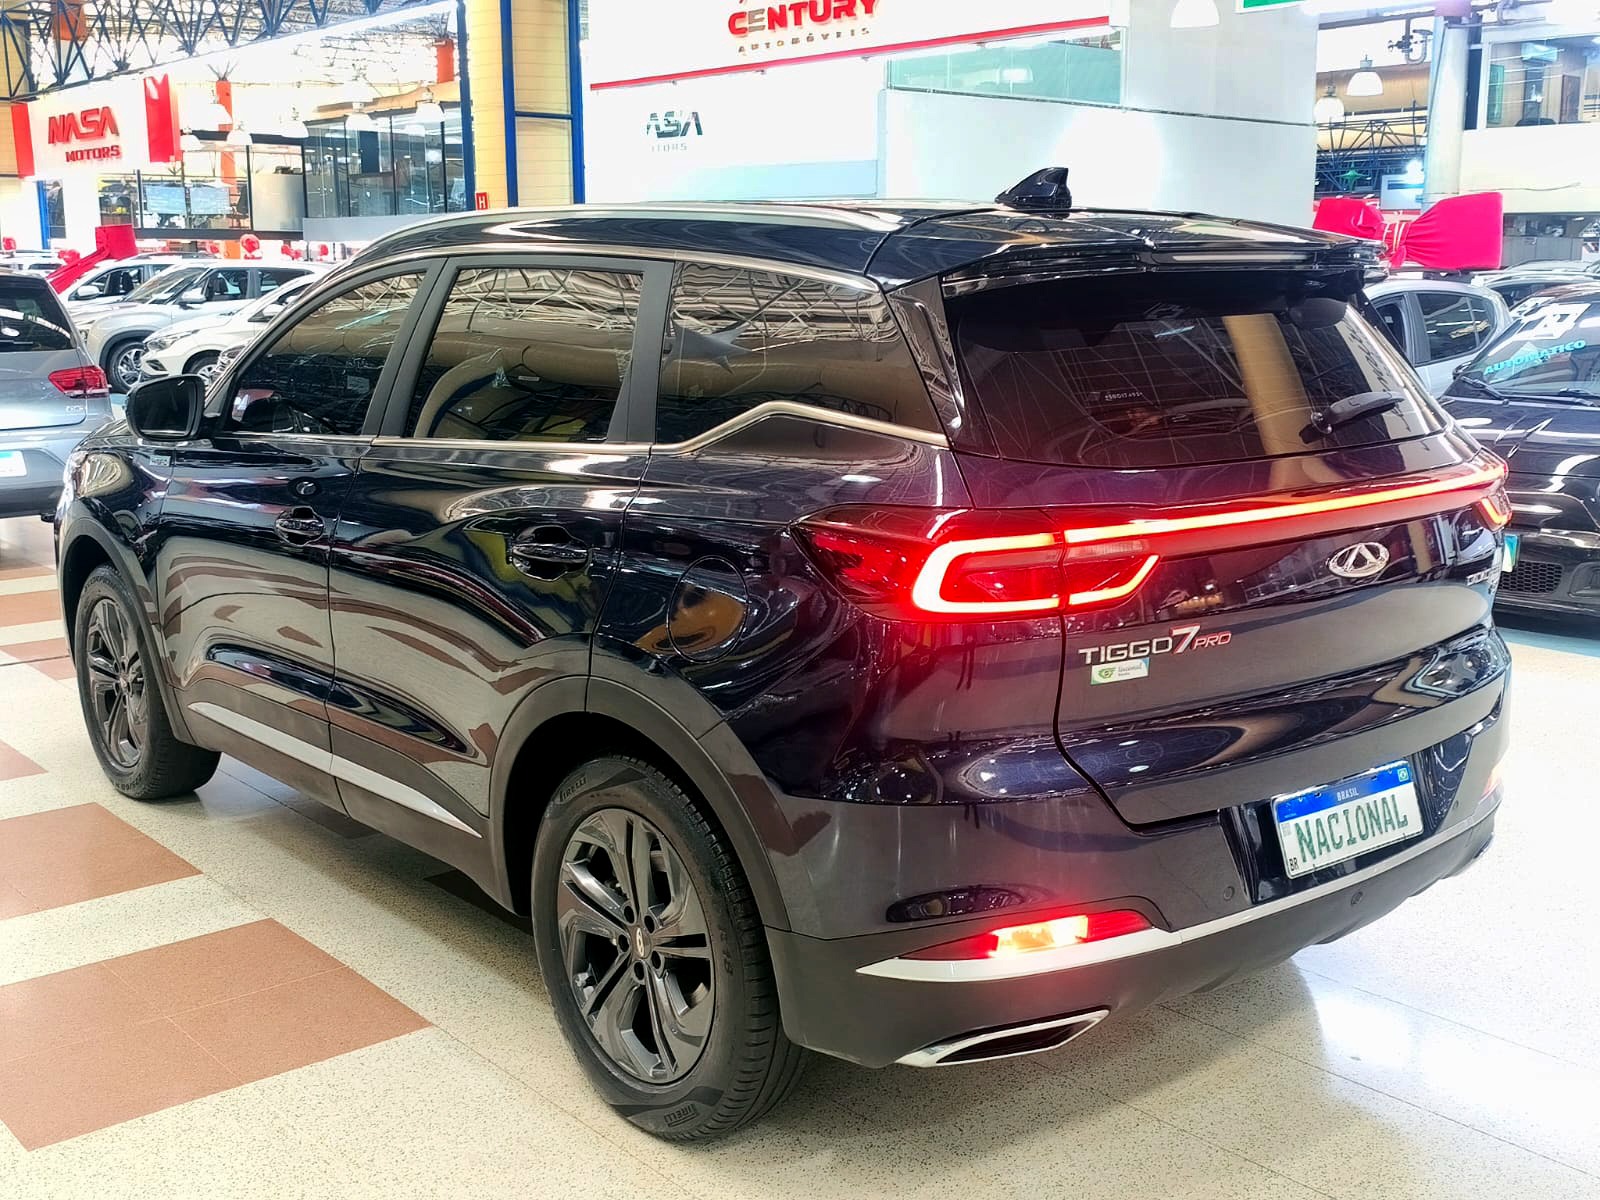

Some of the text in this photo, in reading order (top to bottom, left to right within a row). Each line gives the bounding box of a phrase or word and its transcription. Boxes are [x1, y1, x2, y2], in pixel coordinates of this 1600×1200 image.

[728, 0, 876, 35] CENTURY
[48, 106, 119, 144] NASA
[646, 111, 703, 138] ASA
[65, 145, 121, 162] MOTORS
[1193, 631, 1232, 650] PRO
[1336, 787, 1359, 801] BRASIL
[1295, 794, 1409, 862] NACIONAL
[1288, 857, 1299, 871] BR
